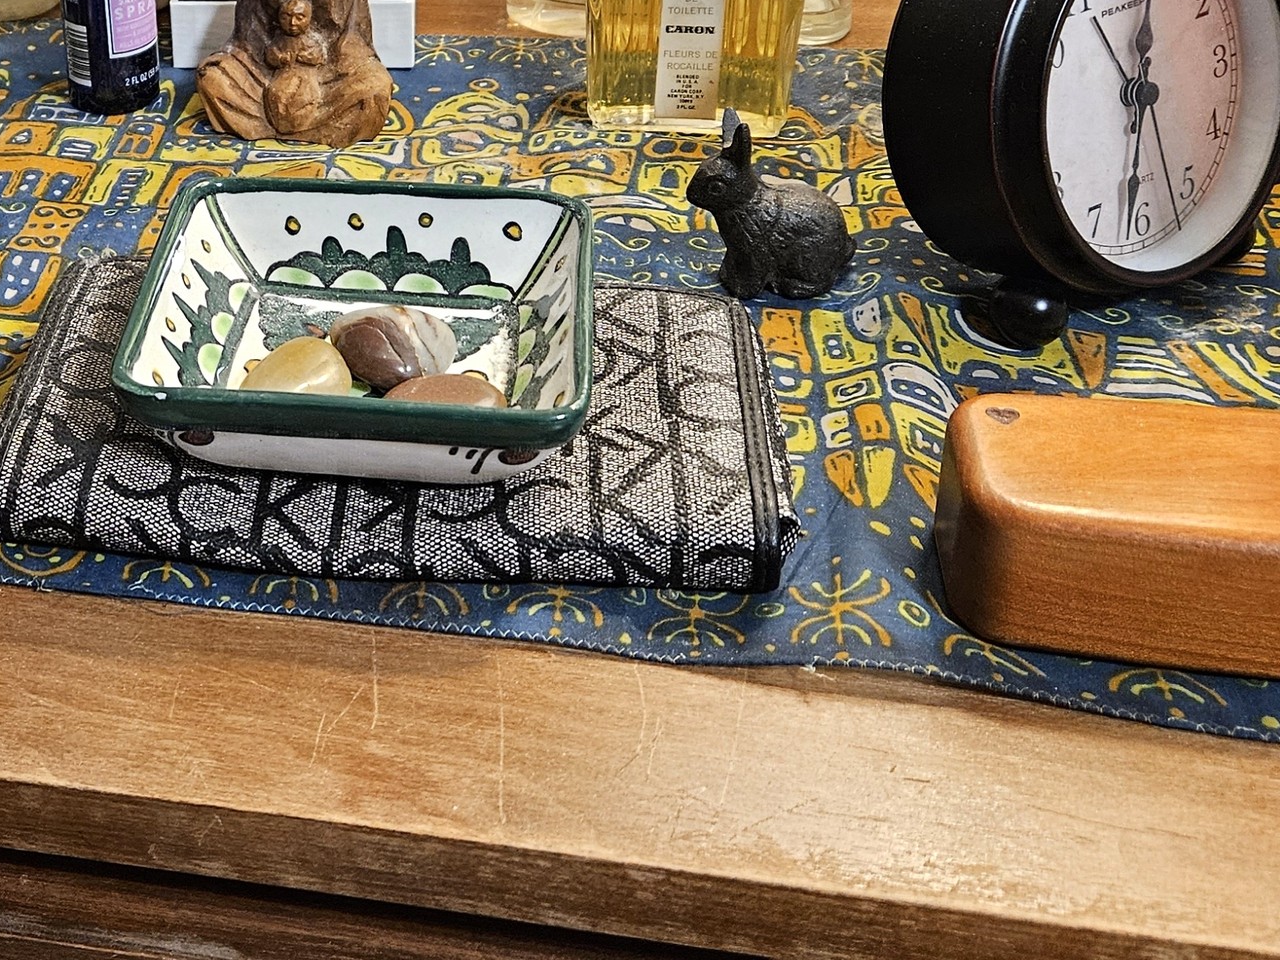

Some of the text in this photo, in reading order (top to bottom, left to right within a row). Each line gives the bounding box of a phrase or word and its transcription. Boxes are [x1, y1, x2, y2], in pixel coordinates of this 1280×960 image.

[668, 6, 715, 16] TOILETTE
[665, 25, 715, 35] CARON
[663, 50, 718, 59] FLEURS DE
[1213, 44, 1228, 79] 3
[666, 62, 714, 71] ROCAILLE
[125, 77, 131, 87] 2
[131, 75, 140, 85] FL
[140, 71, 148, 83] OZ
[1206, 107, 1222, 141] 4
[1140, 171, 1155, 185] RTZ
[1180, 165, 1195, 200] 5
[1086, 202, 1103, 239] 7
[1134, 201, 1151, 237] 6
